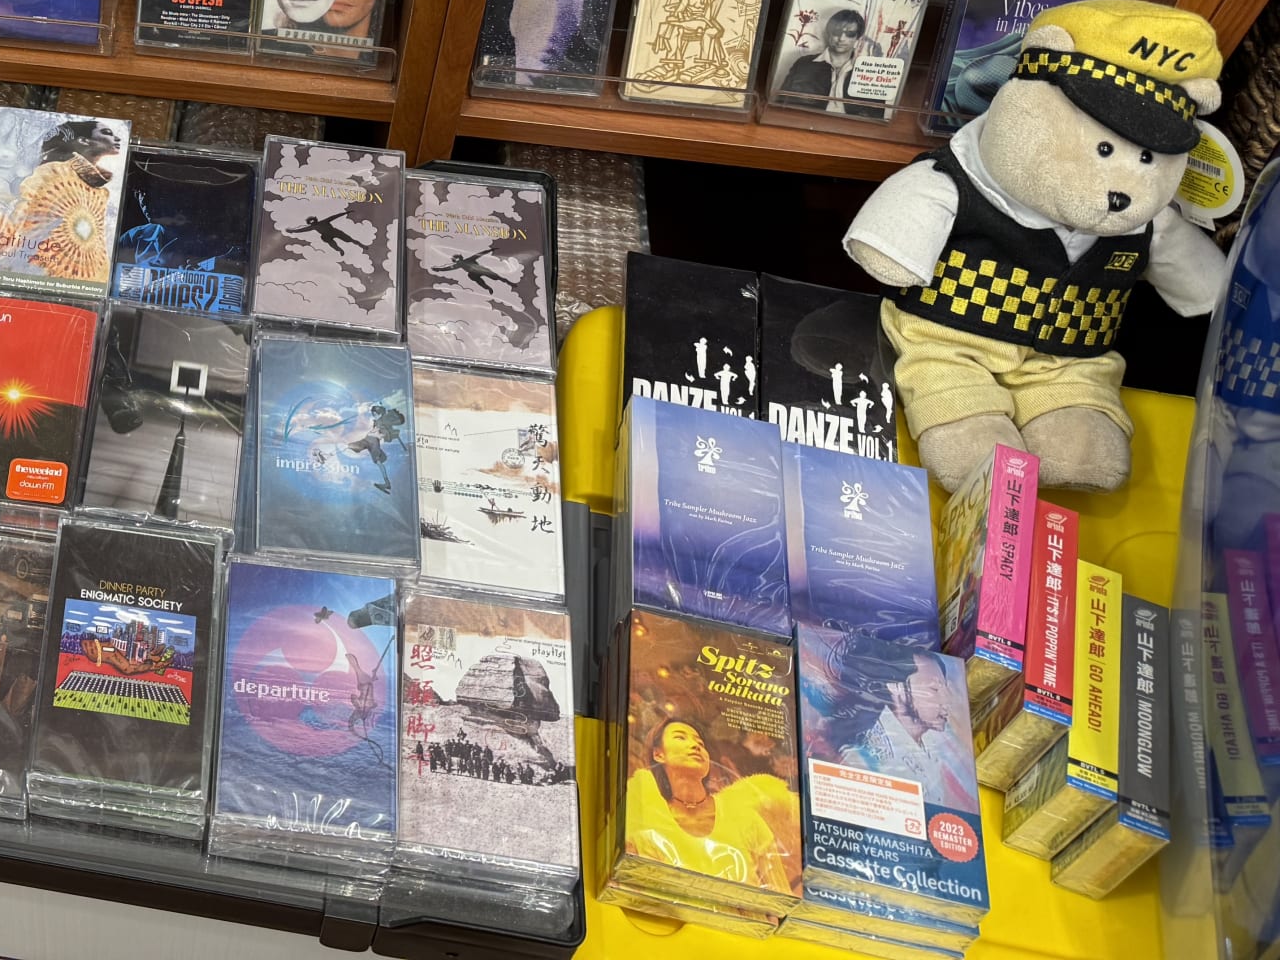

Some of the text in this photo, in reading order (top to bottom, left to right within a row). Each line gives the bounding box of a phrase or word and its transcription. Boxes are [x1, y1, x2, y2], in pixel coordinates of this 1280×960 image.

[1128, 36, 1197, 73] NYC
[277, 180, 308, 195] THE
[312, 184, 384, 204] MANSION
[419, 218, 450, 232] THE
[455, 221, 528, 240] MANSION
[276, 456, 360, 476] impression
[528, 423, 554, 534] 驚天動地
[19, 480, 55, 490] dawn FM
[664, 498, 758, 524] Tribe Sampler Mushroom Jazz
[1000, 480, 1022, 582] 山下達郎 SPACY
[80, 588, 184, 612] ENIGMATIC SOCIETY
[99, 580, 166, 597] DINNER PARTY
[532, 644, 566, 660] playlist
[696, 646, 776, 679] Spitz
[1088, 598, 1107, 734] 山下達郎 GO AHEAD!
[234, 678, 330, 703] departure
[707, 680, 783, 707] tobikata
[724, 671, 790, 696] Sorano
[1136, 632, 1154, 780] 山下達郎 MOONGLOW
[812, 820, 934, 859] TATSURO YAMASHITA
[932, 830, 973, 848] REMASTER
[939, 820, 964, 836] 2023
[813, 834, 900, 862] RCA/AIR YEARS
[940, 841, 967, 854] EDITION
